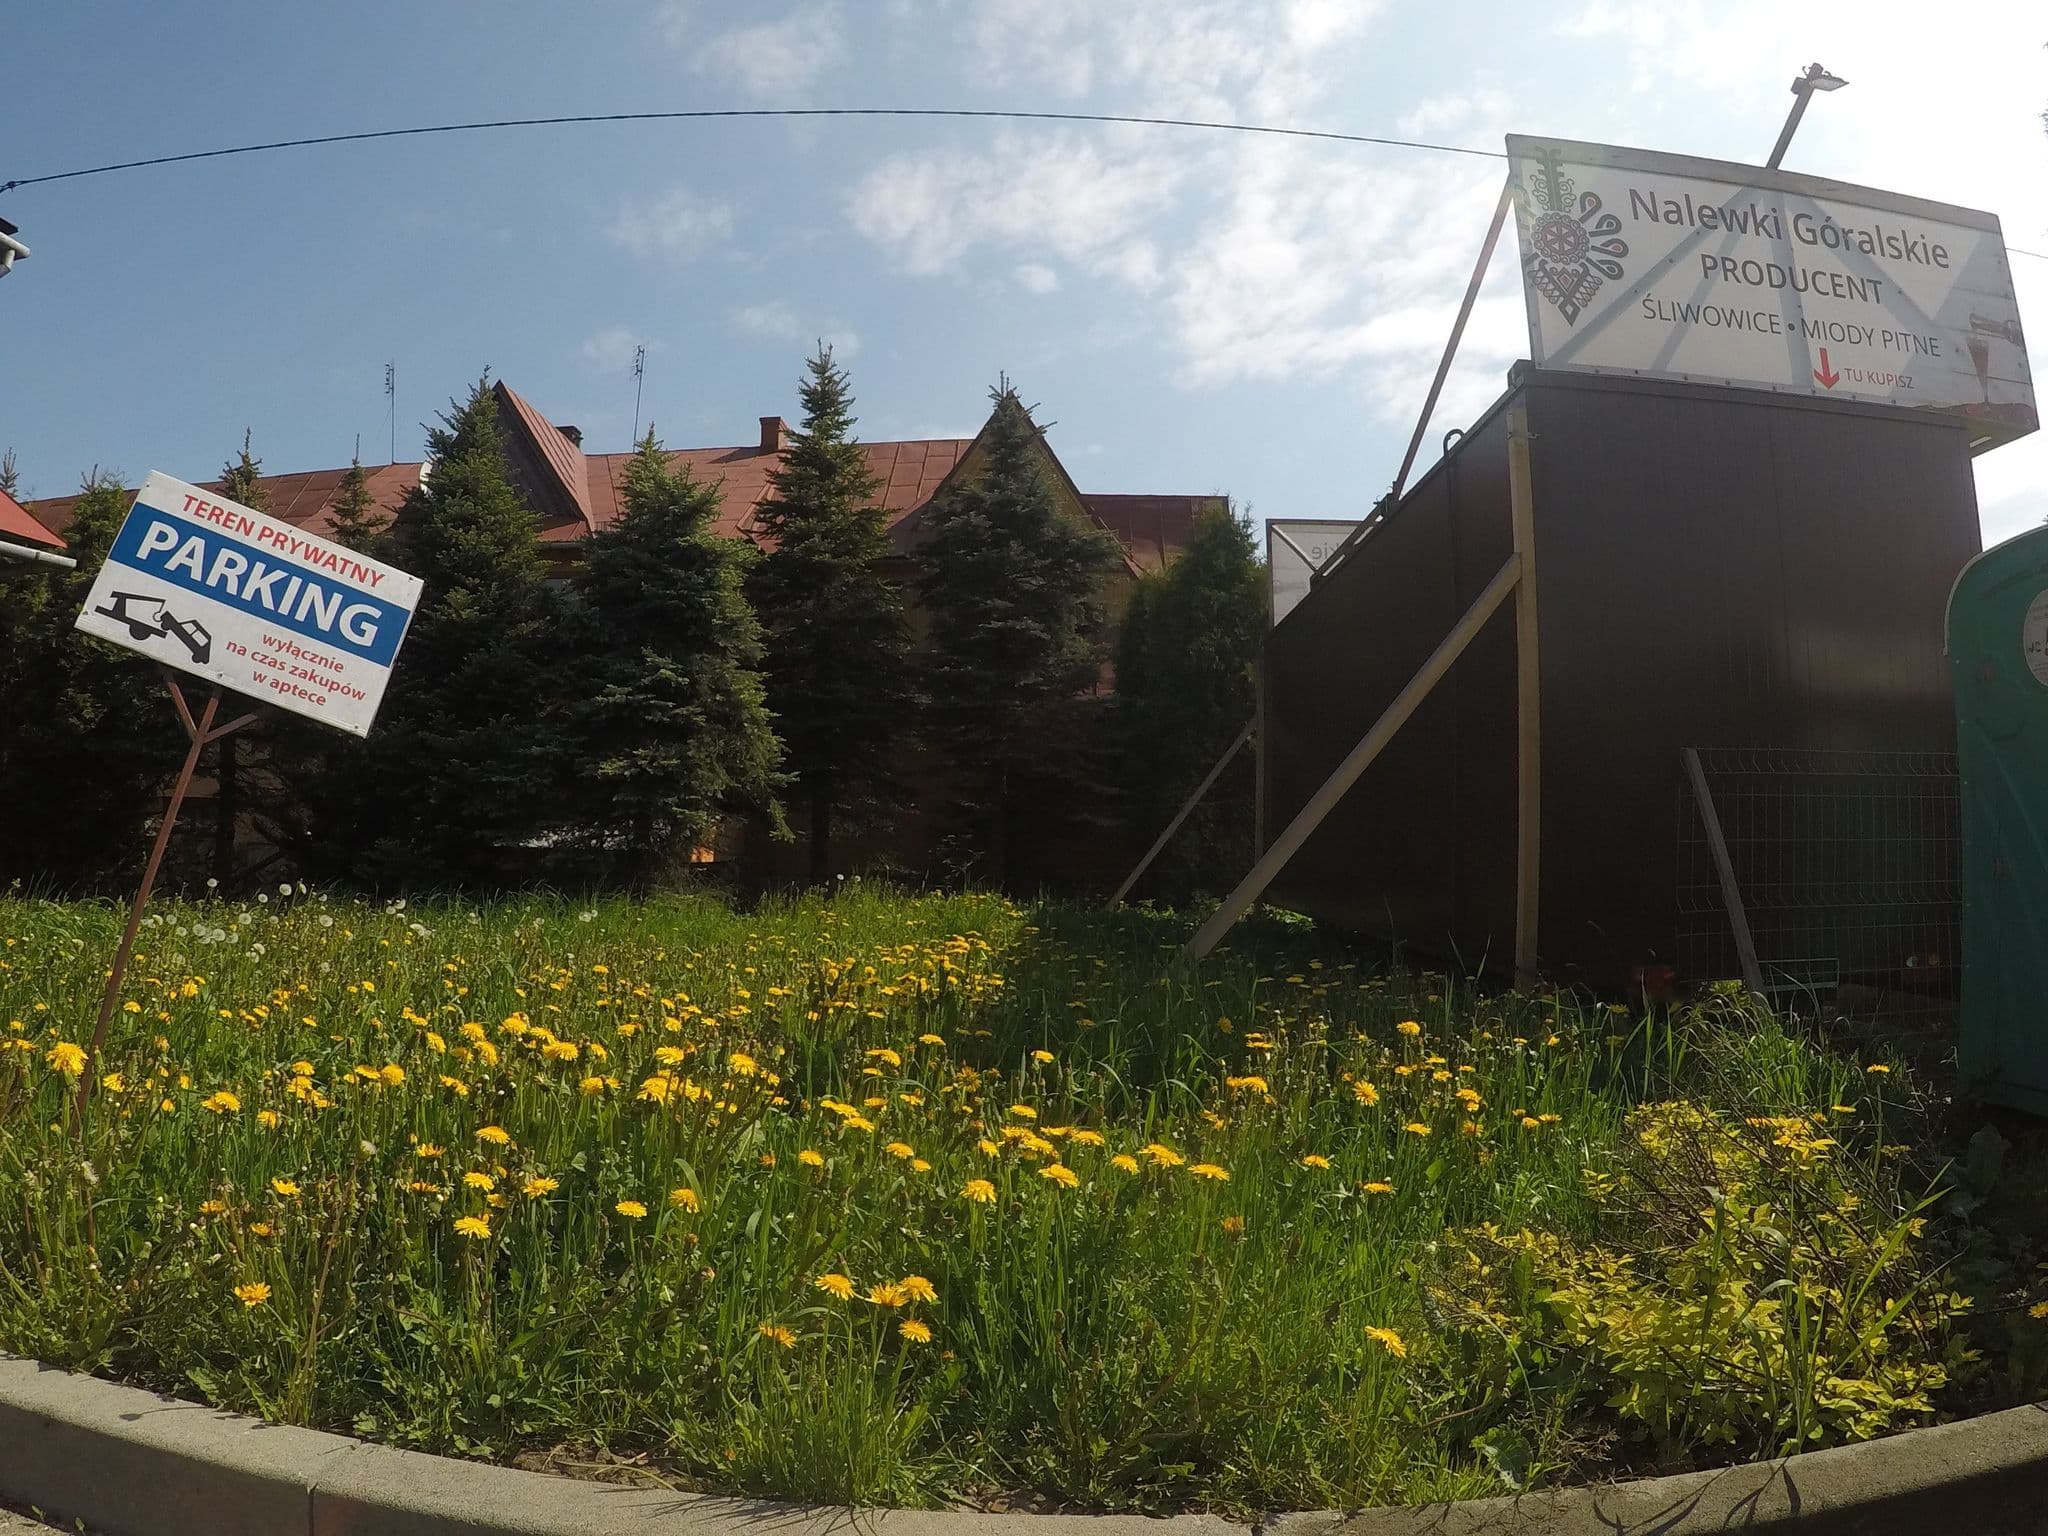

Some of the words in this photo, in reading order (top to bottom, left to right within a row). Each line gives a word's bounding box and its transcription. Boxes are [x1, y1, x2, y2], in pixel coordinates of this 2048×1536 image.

[1629, 188, 1782, 240] Nalewki
[1793, 213, 1950, 269] Góralskie
[1701, 253, 1882, 304] PRODUCENT
[1642, 293, 1782, 335] ŚLIWOWICE
[1800, 318, 1874, 347] MIODY
[1881, 329, 1941, 357] PITNE
[1844, 368, 1863, 383] TU
[1867, 371, 1915, 389] KUPISZ
[182, 494, 255, 537] TEREN
[257, 525, 387, 588] PRYWATNY
[135, 520, 383, 648] PARKING
[225, 640, 247, 656] na
[251, 651, 287, 671] czas
[288, 665, 366, 701] zakupów
[262, 633, 344, 673] wyłącznie
[252, 670, 267, 683] w
[269, 678, 326, 706] aptece
